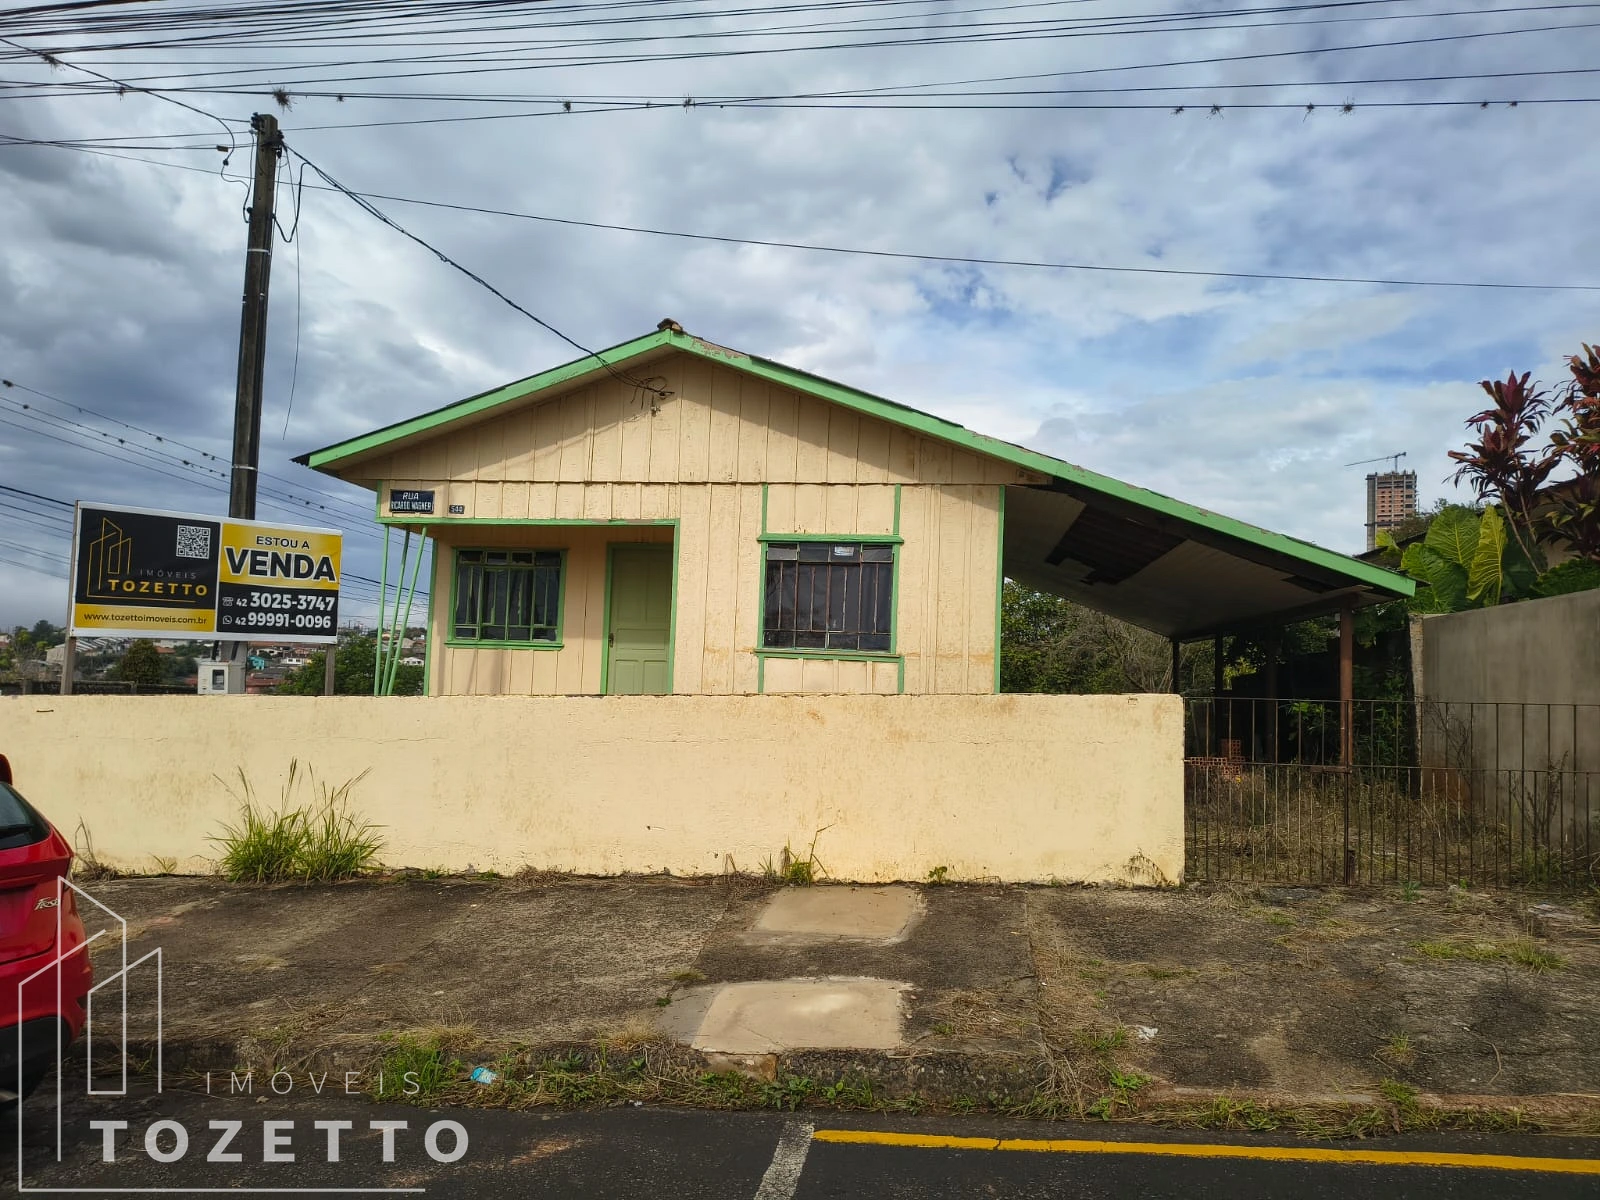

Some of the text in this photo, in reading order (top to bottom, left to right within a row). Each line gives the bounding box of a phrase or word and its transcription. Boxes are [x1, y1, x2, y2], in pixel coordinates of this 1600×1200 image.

[402, 492, 419, 500] RUA
[411, 501, 432, 511] WAGNER
[256, 535, 310, 549] ESTOU A
[224, 546, 336, 582] VENDA
[108, 579, 208, 596] TOZETTO
[236, 591, 335, 611] 42 3025-3747
[83, 612, 208, 625] www.tozettoimoveis.com.br
[235, 611, 332, 628] 42 99991-0096
